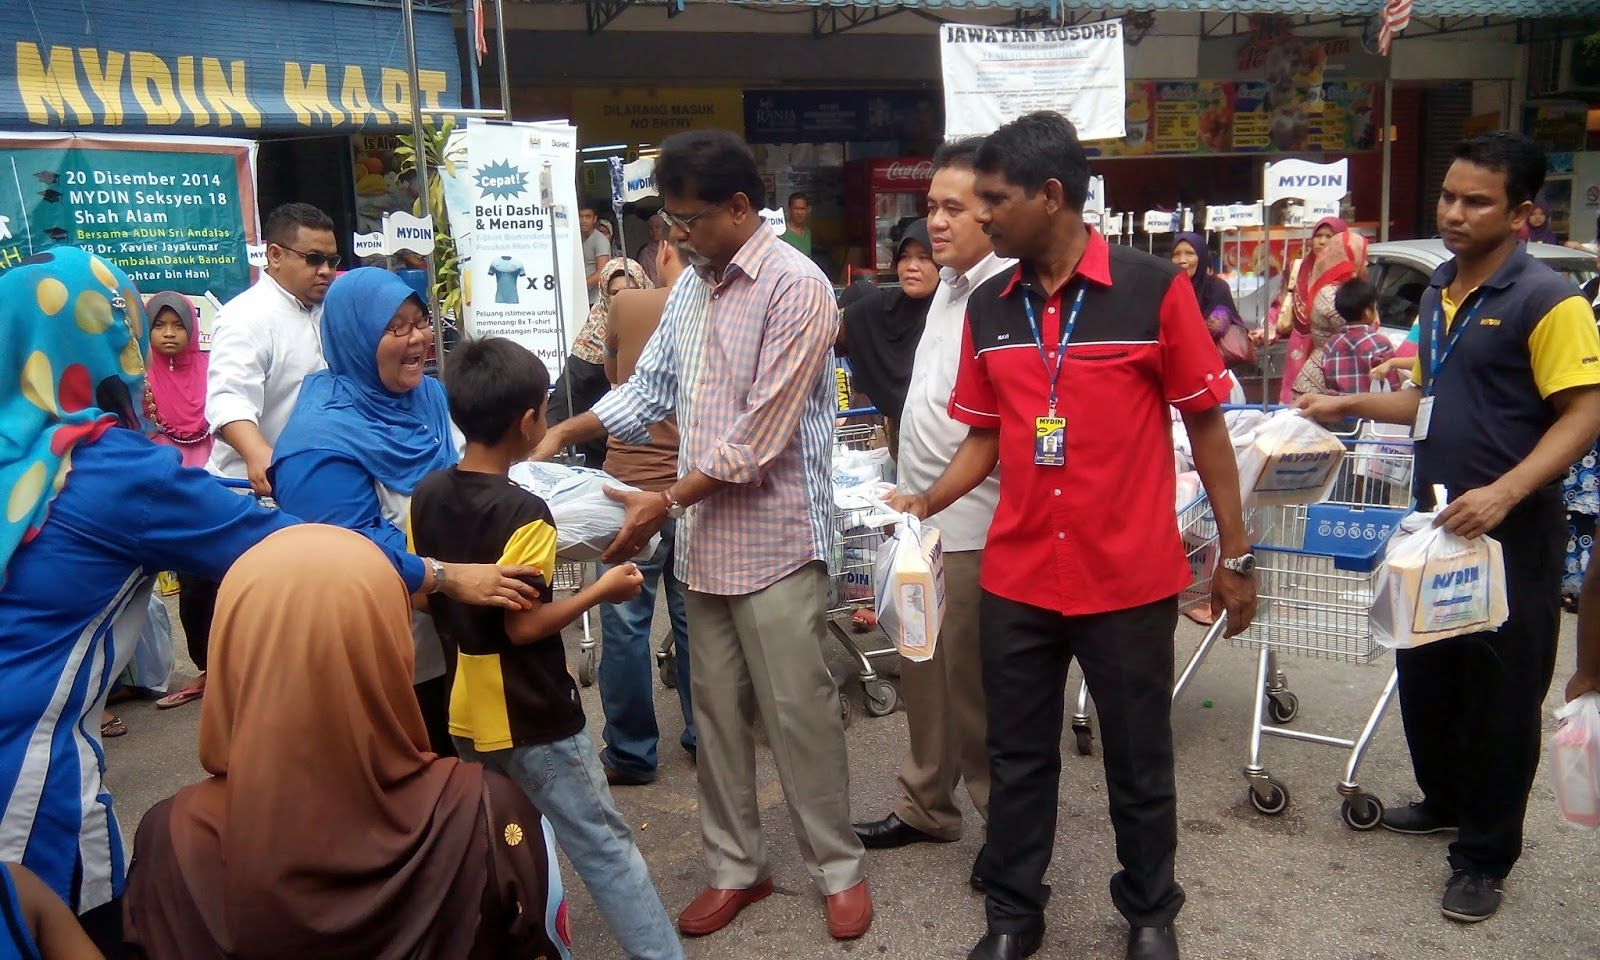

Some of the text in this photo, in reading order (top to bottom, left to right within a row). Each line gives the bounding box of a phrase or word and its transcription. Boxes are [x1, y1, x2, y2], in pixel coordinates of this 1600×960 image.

[947, 23, 1118, 43] JAWATAN KOSONG
[16, 42, 455, 128] MYDIN MART
[602, 104, 715, 116] DILARANG MASUK
[631, 118, 693, 129] NO ENTRY
[66, 171, 221, 187] 20 Disember 2014
[481, 173, 520, 188] Cepat!
[1278, 175, 1343, 187] MYDIN
[70, 191, 227, 207] MYDIN Seksyen 18
[75, 210, 168, 224] Shah Alam
[476, 205, 502, 217] Beli
[476, 218, 544, 231] & Menang
[77, 228, 230, 240] Bersama ADUN Sri Andalas
[397, 227, 431, 240] MYDIN
[98, 245, 116, 254] Dr.
[120, 243, 158, 253] Xavier
[161, 242, 219, 254] Jayakumar
[198, 255, 236, 264] Bandar
[128, 269, 210, 281] ohtar bin Hani
[526, 274, 555, 290] x 8
[476, 319, 517, 327] memenangi
[537, 349, 566, 358] Mydn
[836, 367, 849, 411] MYDIN
[1279, 451, 1330, 463] MYDIN
[1432, 565, 1479, 590] MYDIN
